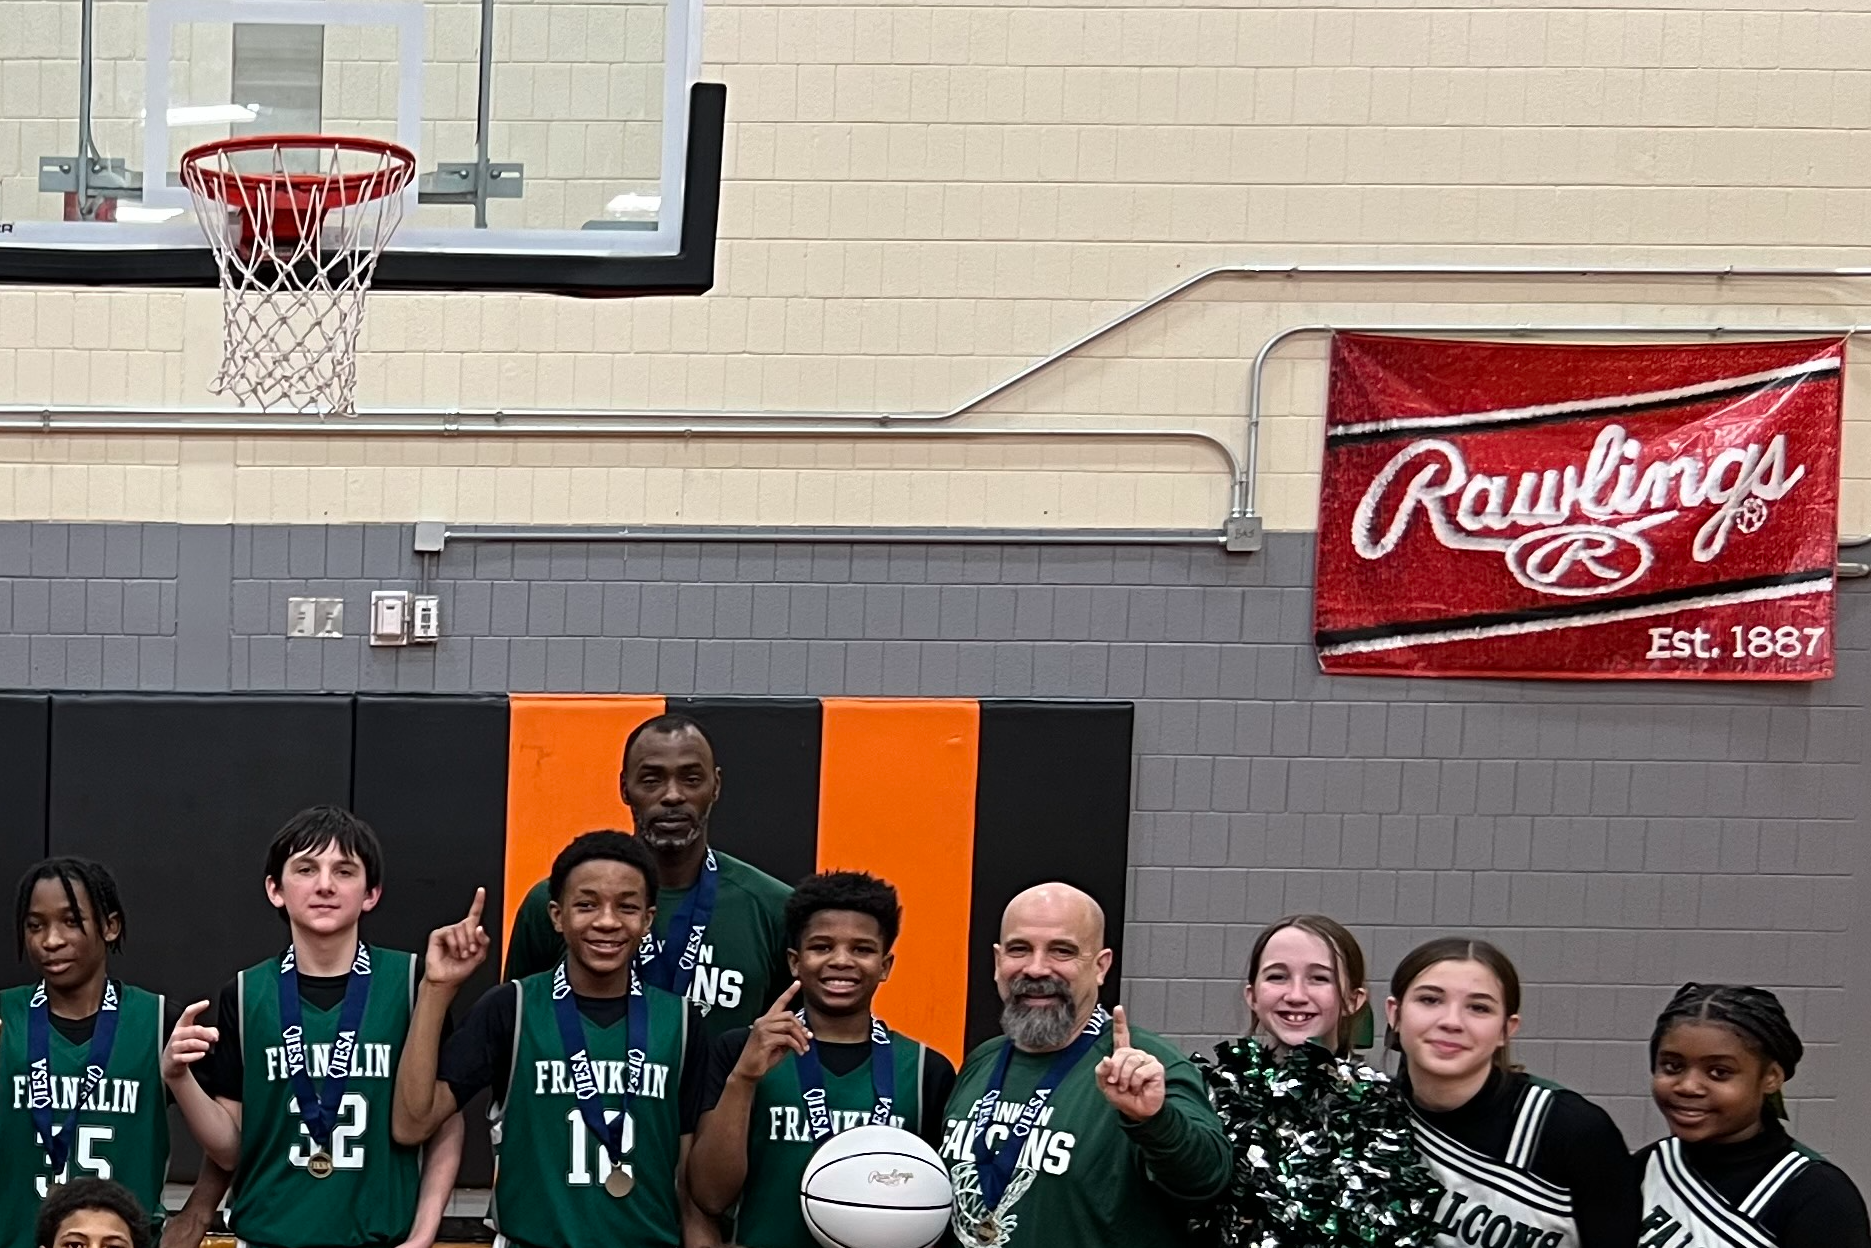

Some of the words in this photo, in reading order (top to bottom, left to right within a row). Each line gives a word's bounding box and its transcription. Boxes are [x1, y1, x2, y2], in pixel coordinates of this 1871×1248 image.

[1352, 425, 1805, 561] Rawlings
[1646, 626, 1719, 660] Est.
[1732, 625, 1825, 659] 1887
[685, 925, 706, 961] IESA
[285, 1036, 304, 1076] IESA
[333, 1031, 355, 1071] IESA
[570, 1050, 596, 1090] IESA
[31, 1058, 50, 1098] IESA
[535, 1060, 669, 1100] FRNKIN
[807, 1098, 831, 1140] IESA
[872, 1097, 893, 1126] ESA
[1024, 1088, 1051, 1126] IESA
[938, 1119, 1076, 1176] FALCNS
